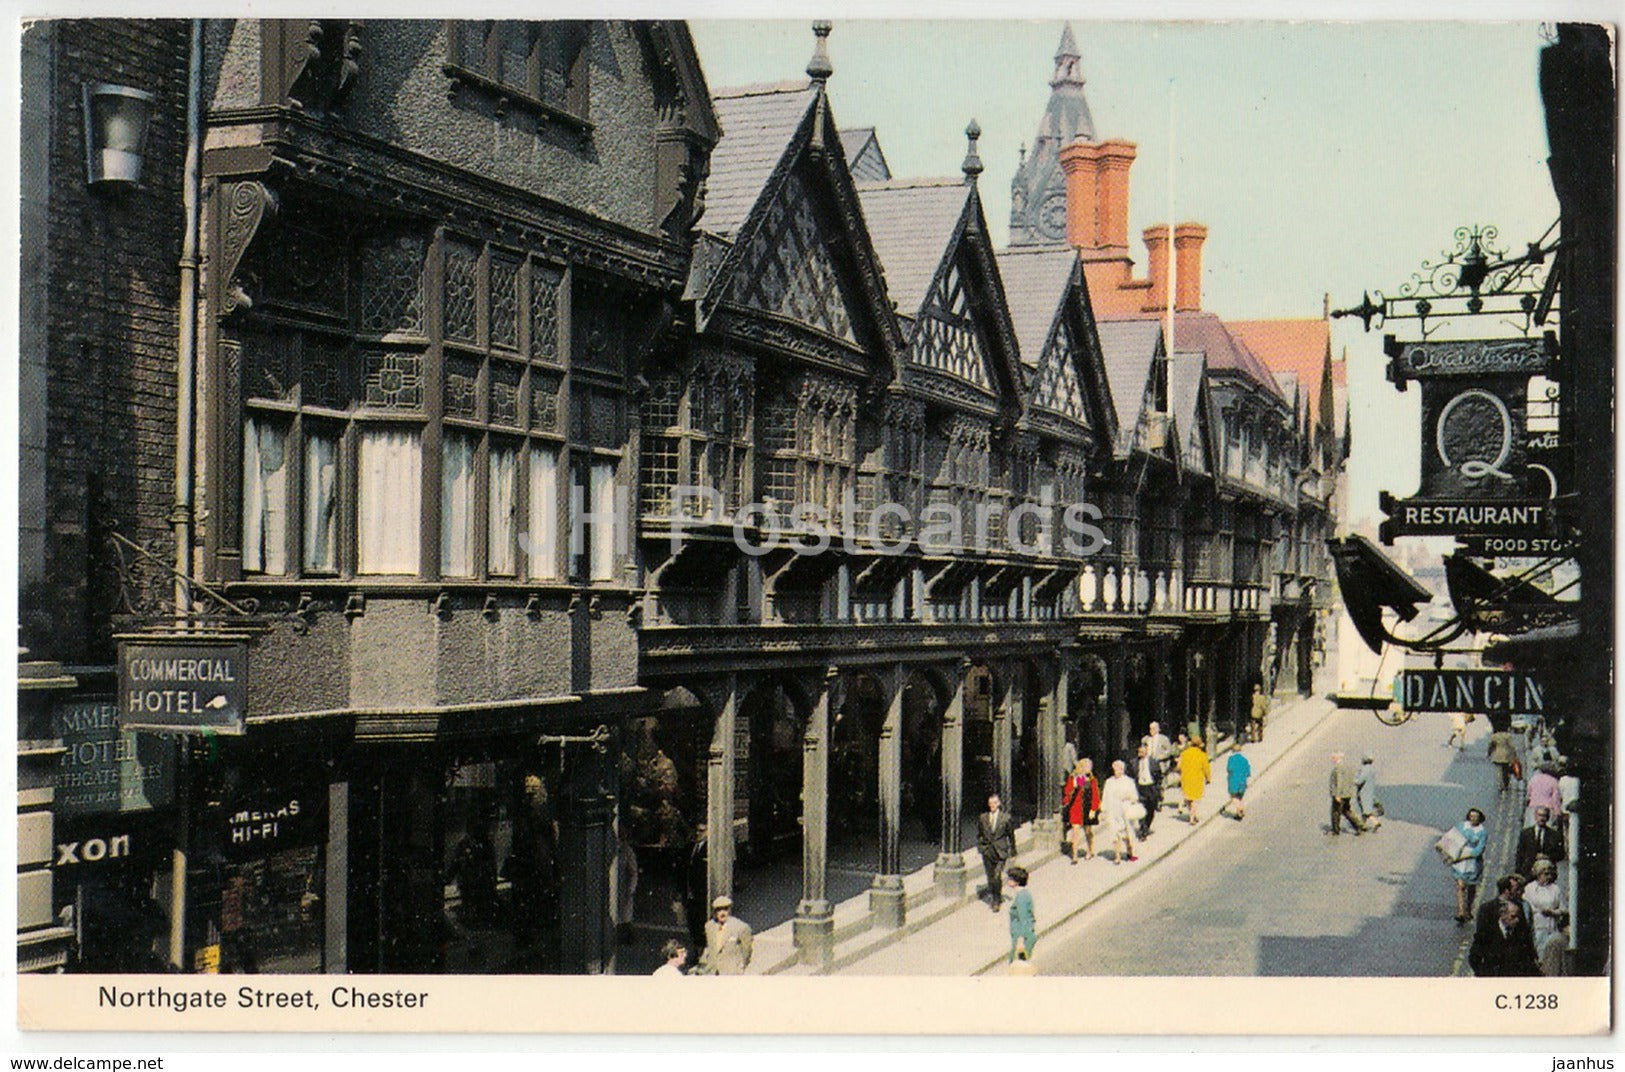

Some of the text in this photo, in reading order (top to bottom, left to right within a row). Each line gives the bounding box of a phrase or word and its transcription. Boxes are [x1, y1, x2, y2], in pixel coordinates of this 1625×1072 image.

[1436, 388, 1513, 479] Q
[1405, 506, 1543, 525] RESTAURANT
[1485, 539, 1527, 551] FOOD
[130, 659, 236, 681] COMMERCIAL
[129, 690, 203, 713] HOTEL
[1406, 675, 1544, 710] DANCIN
[60, 740, 136, 766] HOTEL
[232, 822, 278, 843] HI-FI
[56, 835, 130, 865] xon
